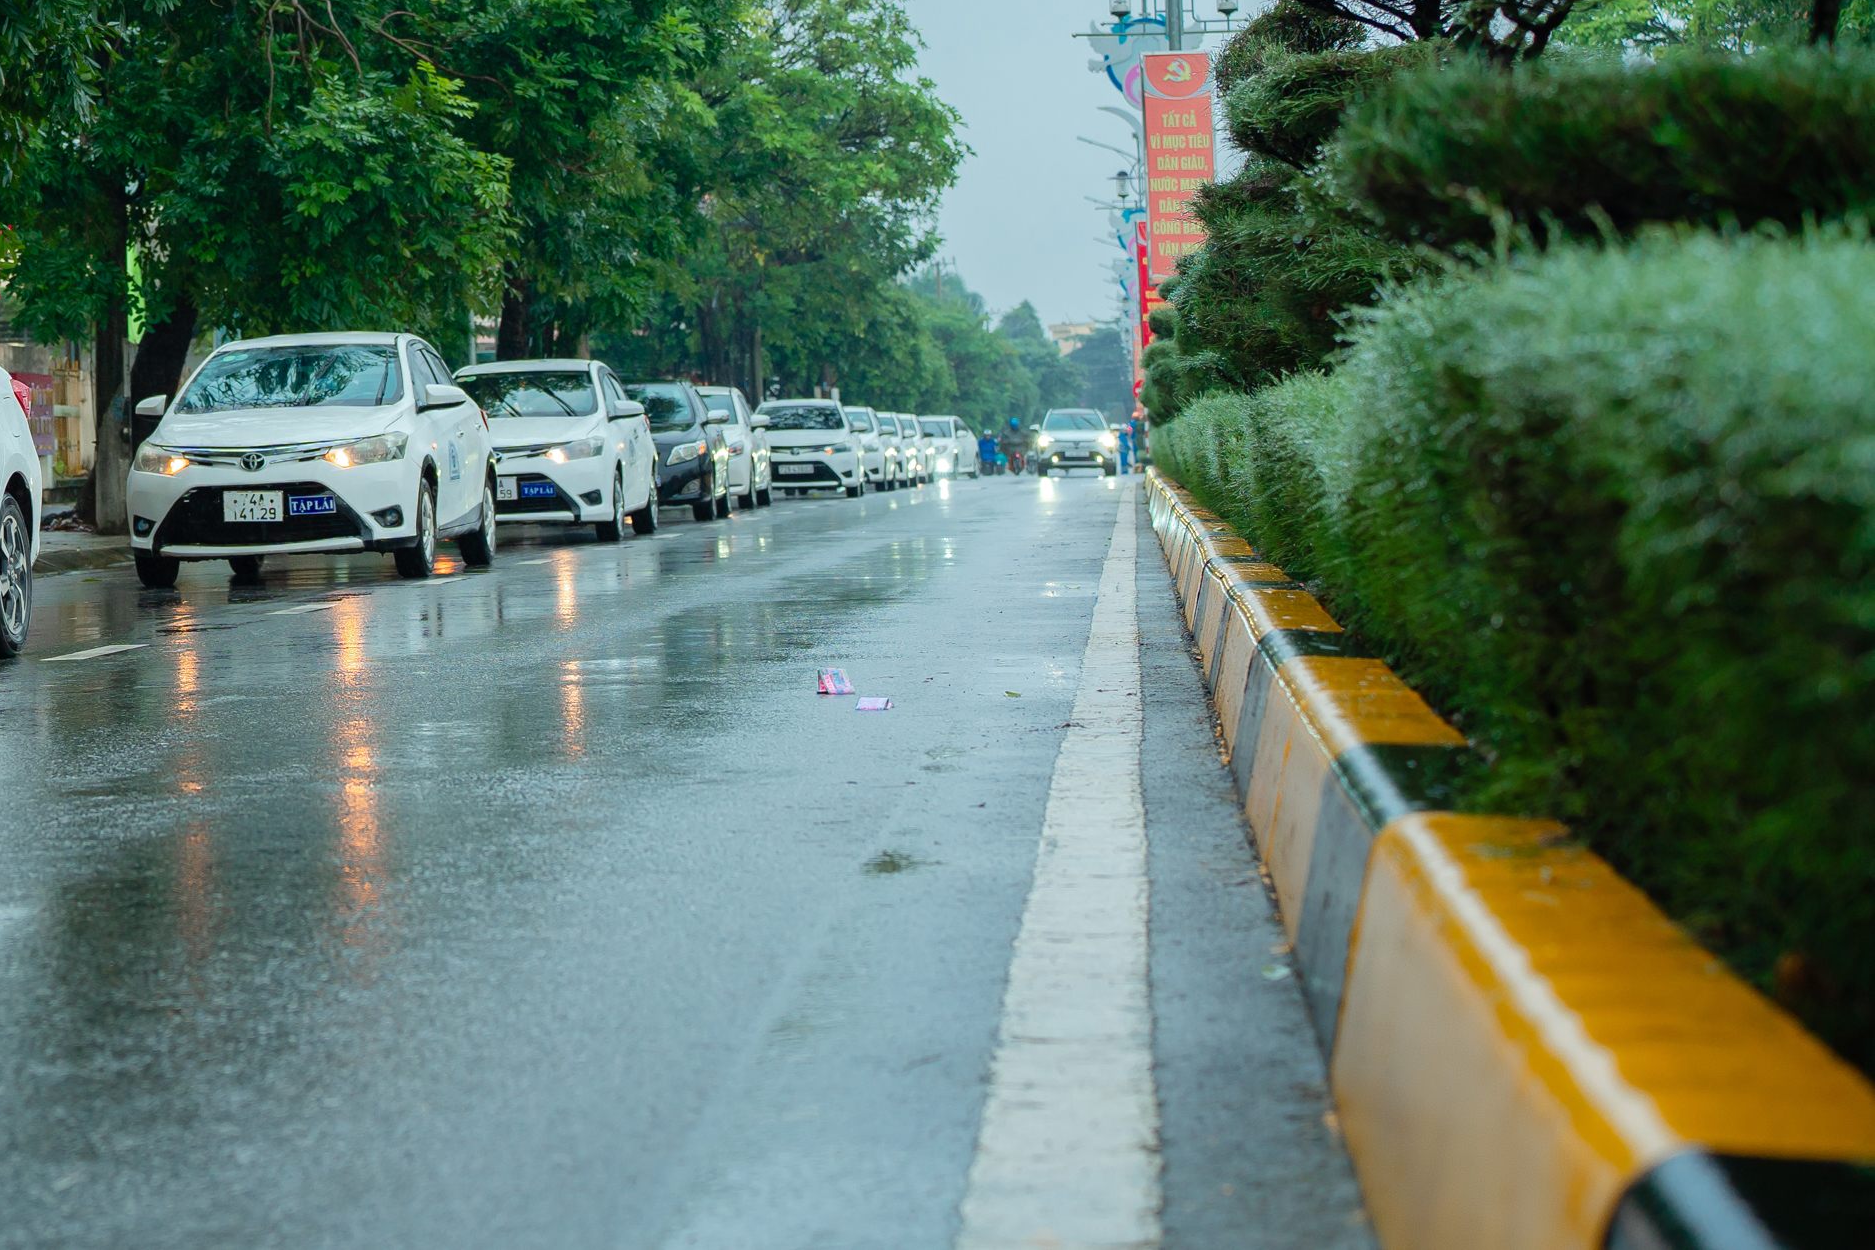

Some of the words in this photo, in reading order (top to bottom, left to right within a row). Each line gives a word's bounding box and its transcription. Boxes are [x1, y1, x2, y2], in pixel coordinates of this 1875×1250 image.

[1161, 109, 1180, 128] TẤT
[1162, 135, 1186, 152] MỤC
[1188, 132, 1210, 149] TIÊU
[1157, 154, 1179, 171] DÂN
[1153, 219, 1181, 235] CÔNG
[242, 493, 264, 506] 4A
[291, 500, 312, 513] TẬP
[314, 497, 333, 510] LÁI
